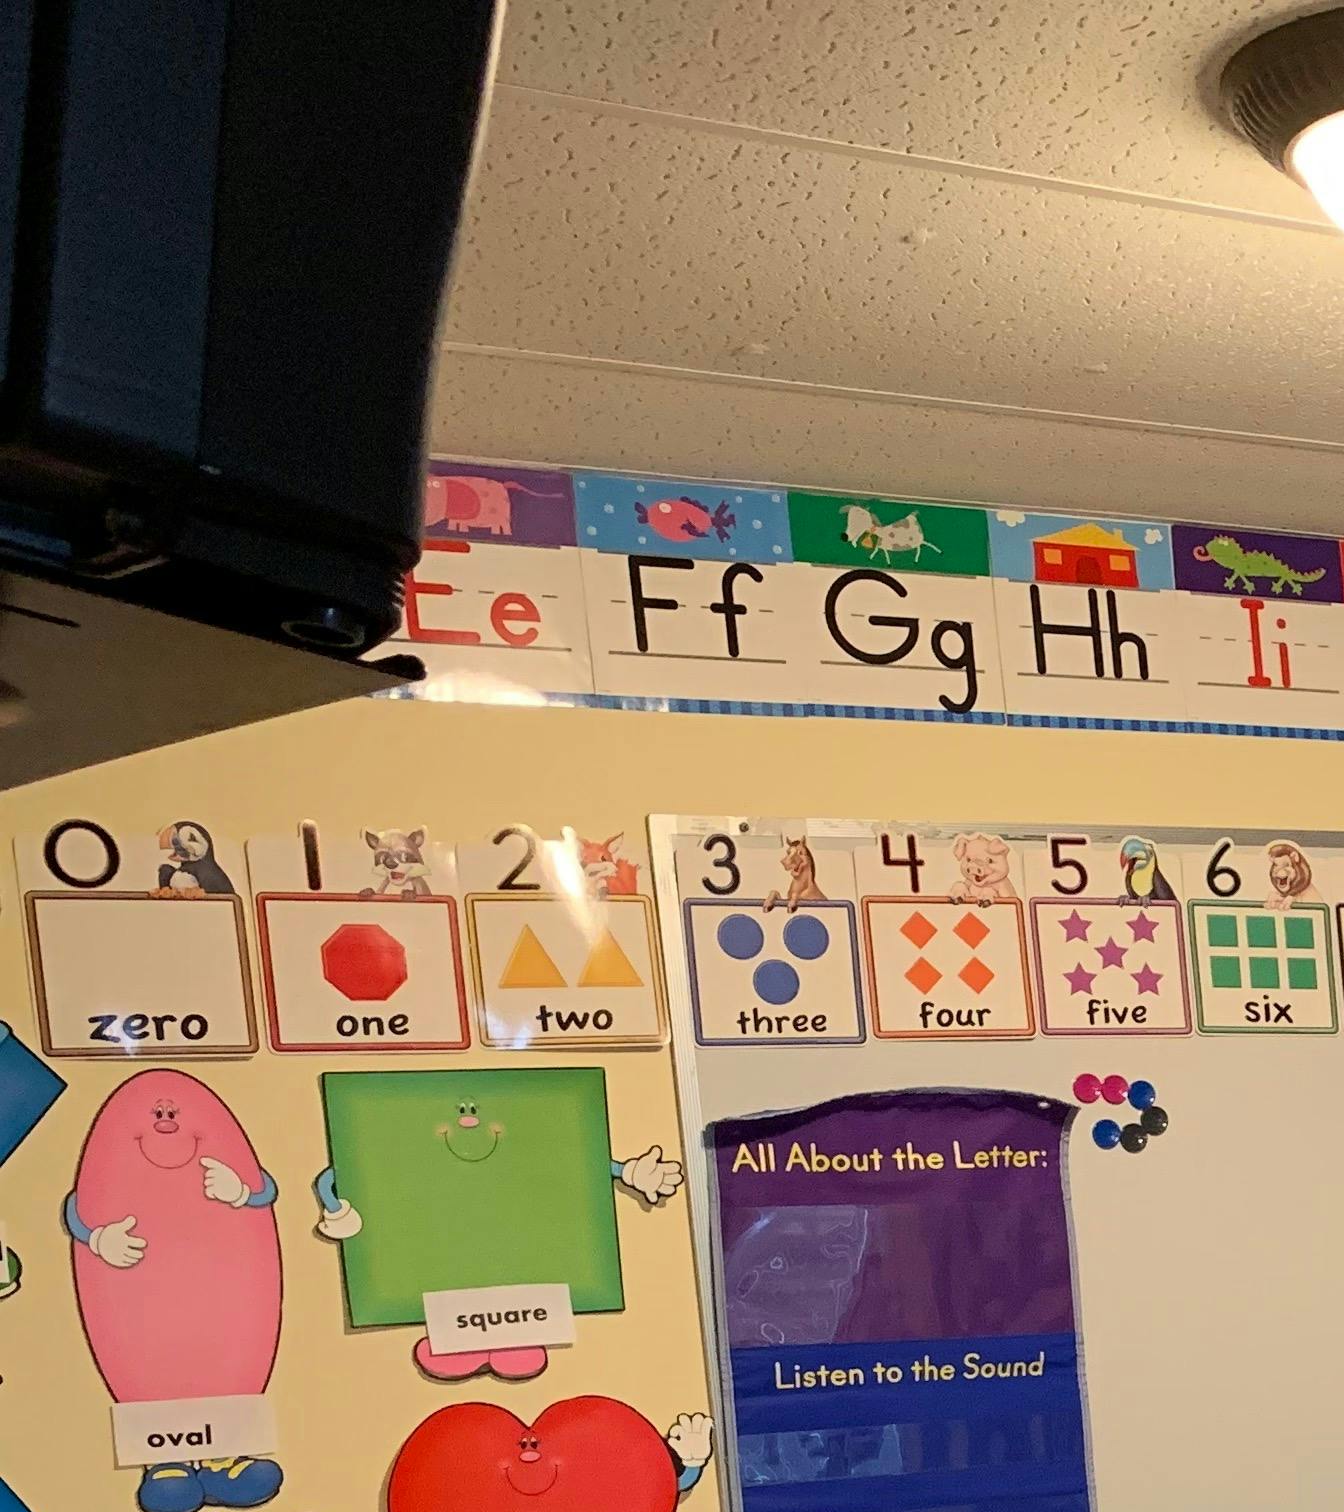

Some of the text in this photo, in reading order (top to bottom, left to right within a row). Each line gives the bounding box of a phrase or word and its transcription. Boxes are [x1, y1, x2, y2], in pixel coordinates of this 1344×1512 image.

[406, 541, 541, 647] Ee
[627, 555, 762, 658] Ff
[824, 570, 978, 714] Gg
[1030, 584, 1149, 681] Hh
[1240, 599, 1291, 688] Ii
[336, 1009, 410, 1038] one
[536, 1005, 613, 1033] two
[737, 1006, 827, 1034] three
[919, 1000, 991, 1030] four
[1086, 999, 1148, 1026] five
[1244, 1000, 1293, 1024] six
[88, 1009, 209, 1045] zero
[732, 1141, 1048, 1173] All About the Letter:
[456, 1306, 548, 1334] square
[775, 1352, 1045, 1389] Listen to the Sound
[147, 1425, 213, 1449] oval
